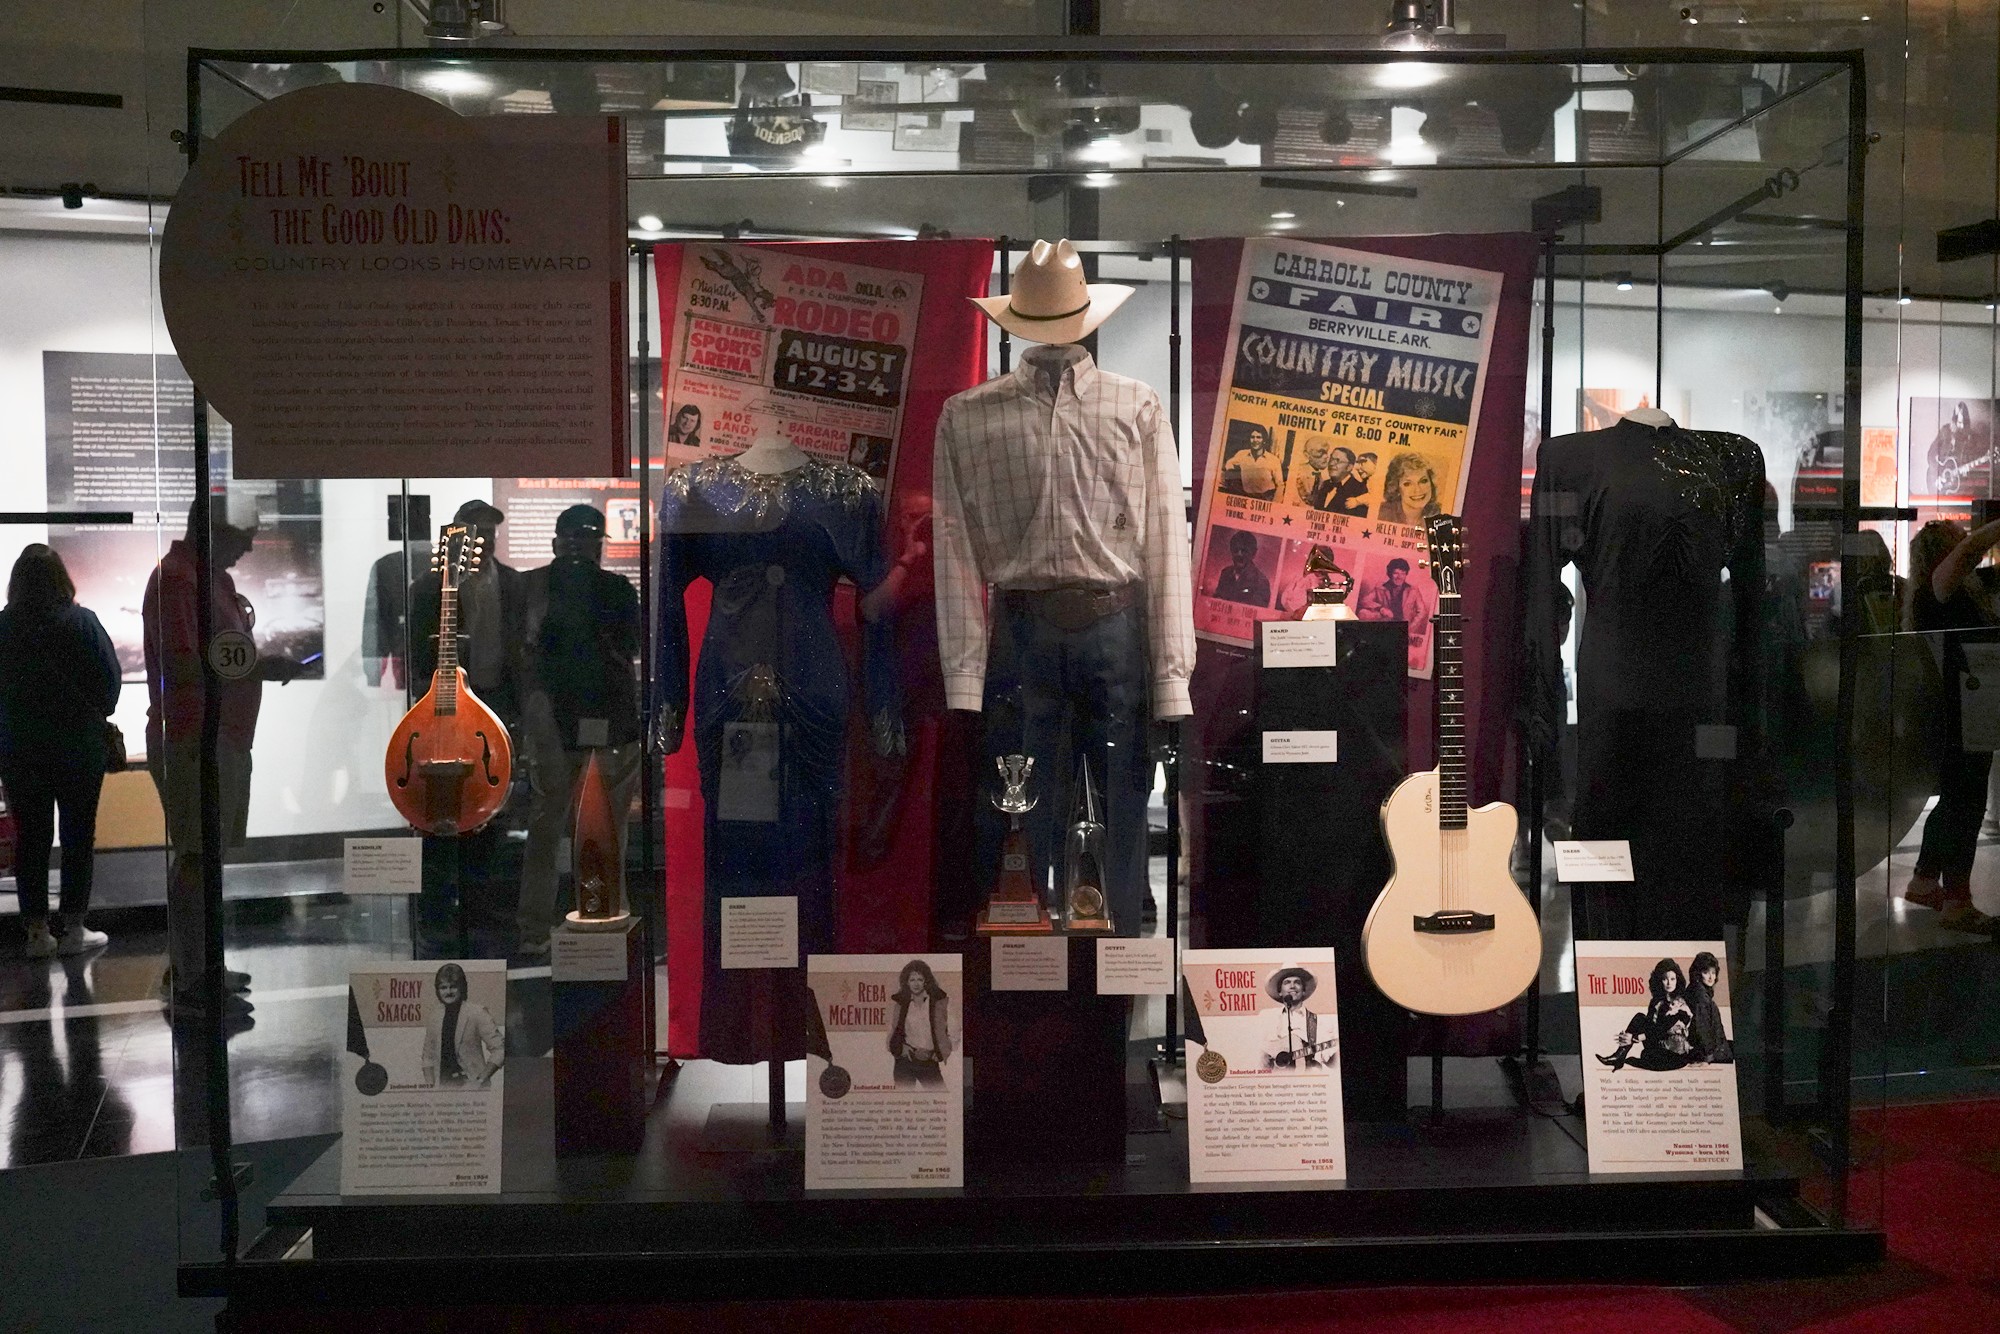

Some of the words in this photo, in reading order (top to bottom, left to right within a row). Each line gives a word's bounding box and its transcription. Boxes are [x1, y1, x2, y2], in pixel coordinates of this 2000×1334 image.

[237, 156, 289, 198] TELL
[299, 156, 333, 197] ME
[270, 208, 312, 245] THE
[322, 204, 384, 245] GOOD
[393, 204, 438, 245] OLD
[447, 204, 511, 245] DAYS:
[233, 257, 350, 272] COUNTRY
[361, 257, 441, 272] LOOKS
[451, 257, 592, 271] HOMEWARD
[781, 264, 848, 293] ADA
[1273, 252, 1372, 290] CARROLL
[1384, 270, 1474, 305] COUNTY
[543, 301, 563, 309] club
[1289, 286, 1443, 329] FAIR
[694, 320, 722, 335] KEN
[773, 296, 900, 344] RODEO
[690, 332, 763, 358] SPORTS
[691, 349, 753, 373] ARENA
[786, 339, 898, 373] AUGUST
[1243, 331, 1379, 384] COUNTRY
[1386, 355, 1474, 400] MUSIC
[787, 363, 890, 397] 1-2-3-4
[1319, 381, 1385, 410] SPECIAL
[722, 410, 752, 426] MOE
[1271, 400, 1329, 417] ARKANSAS'
[1330, 410, 1382, 426] GREATEST
[1385, 419, 1432, 434] COUNTRY
[713, 420, 759, 438] BANDY
[788, 422, 847, 441] BARBARA
[1277, 413, 1331, 433] NIGHTLY
[1333, 422, 1349, 436] AT
[1355, 426, 1382, 442] 8:00
[1388, 431, 1412, 447] P.M.
[710, 437, 730, 446] RODEO
[1225, 496, 1248, 509] GEORGE
[1249, 500, 1272, 513] STRAIT
[1250, 514, 1267, 525] SEPT.
[1269, 517, 1275, 526] 9
[1305, 510, 1330, 524] GROVER
[1306, 530, 1322, 541] SEPT.
[1339, 536, 1346, 545] 10
[1375, 523, 1398, 536] HELEN
[1400, 526, 1426, 540] CORNEL
[220, 647, 246, 667] 30
[389, 978, 423, 999] RICKY
[1215, 968, 1256, 989] GEORGE
[1588, 974, 1608, 995] THE
[1612, 974, 1645, 995] JUDDS
[858, 982, 887, 1003] REBA
[1219, 991, 1257, 1012] STRAIT
[377, 1002, 422, 1022] SKAGGS
